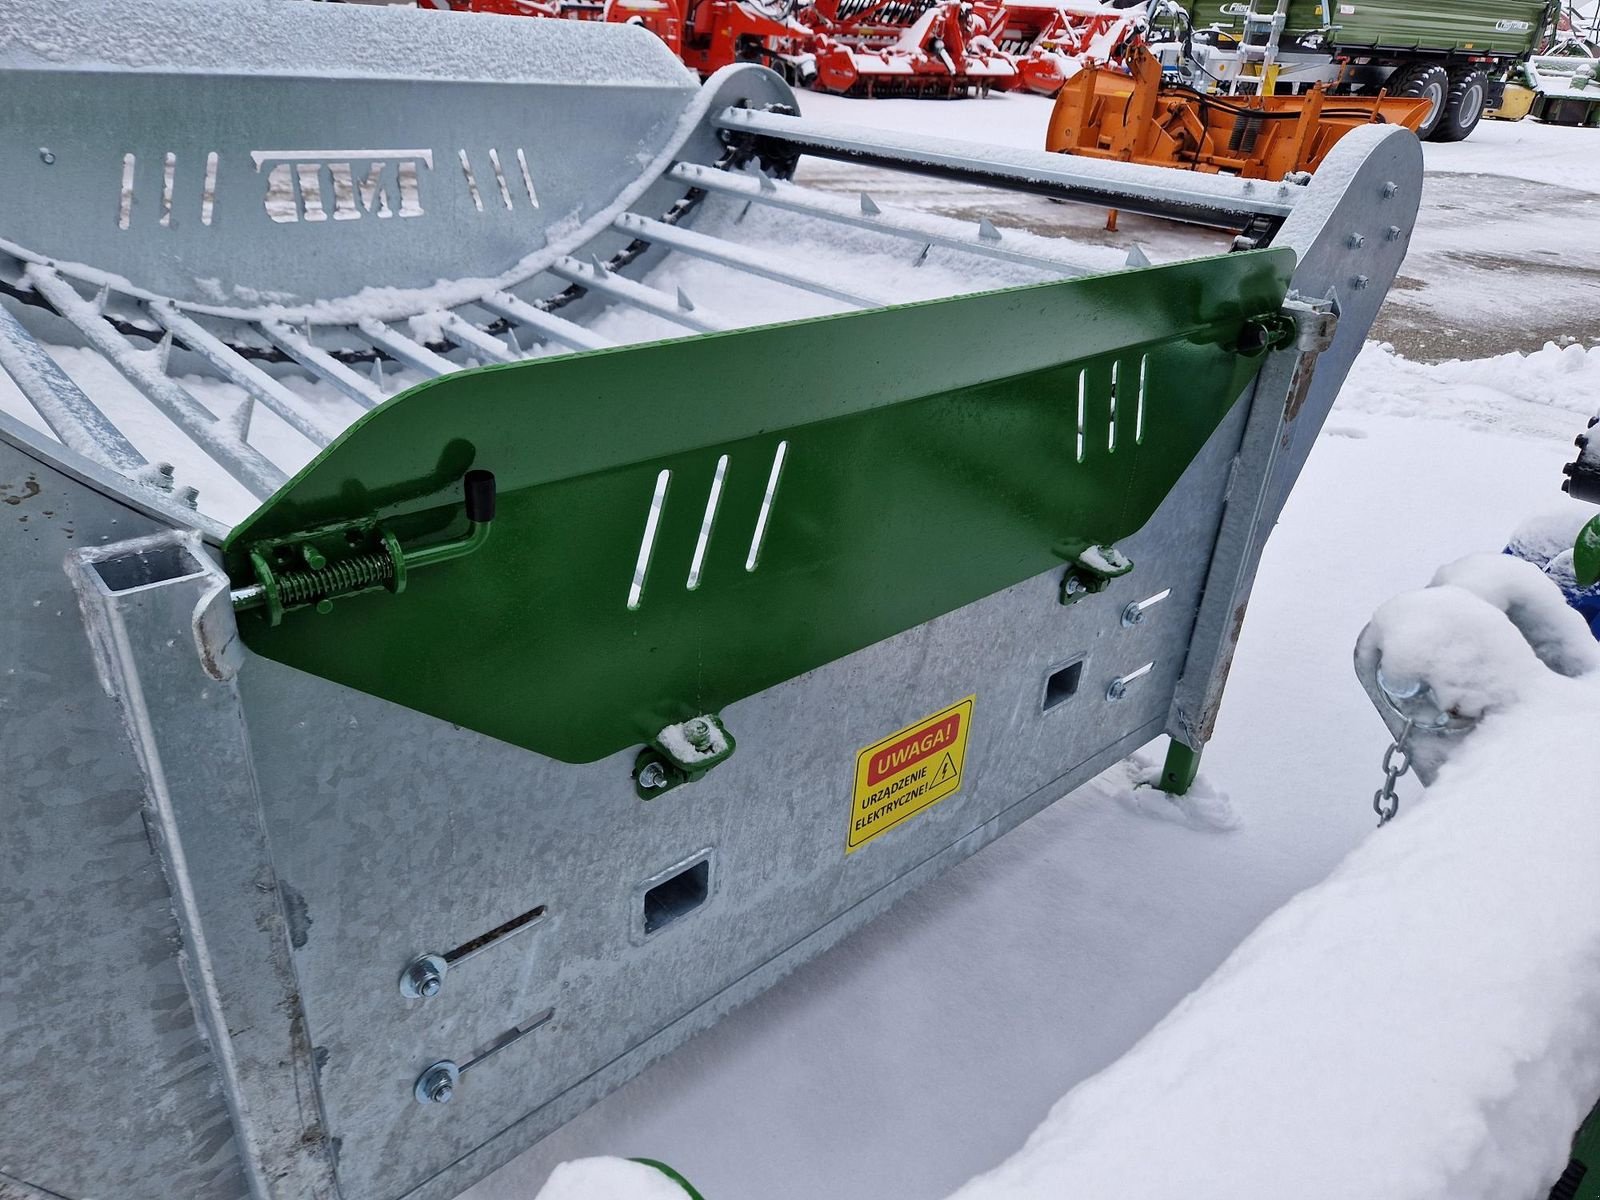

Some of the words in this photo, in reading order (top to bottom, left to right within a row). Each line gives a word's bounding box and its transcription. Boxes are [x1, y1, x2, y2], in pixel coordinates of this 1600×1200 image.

[877, 723, 952, 775] UWAGA!
[855, 782, 929, 831] ELEKTRYCZNE!
[861, 766, 928, 810] URZĄDZENIE
